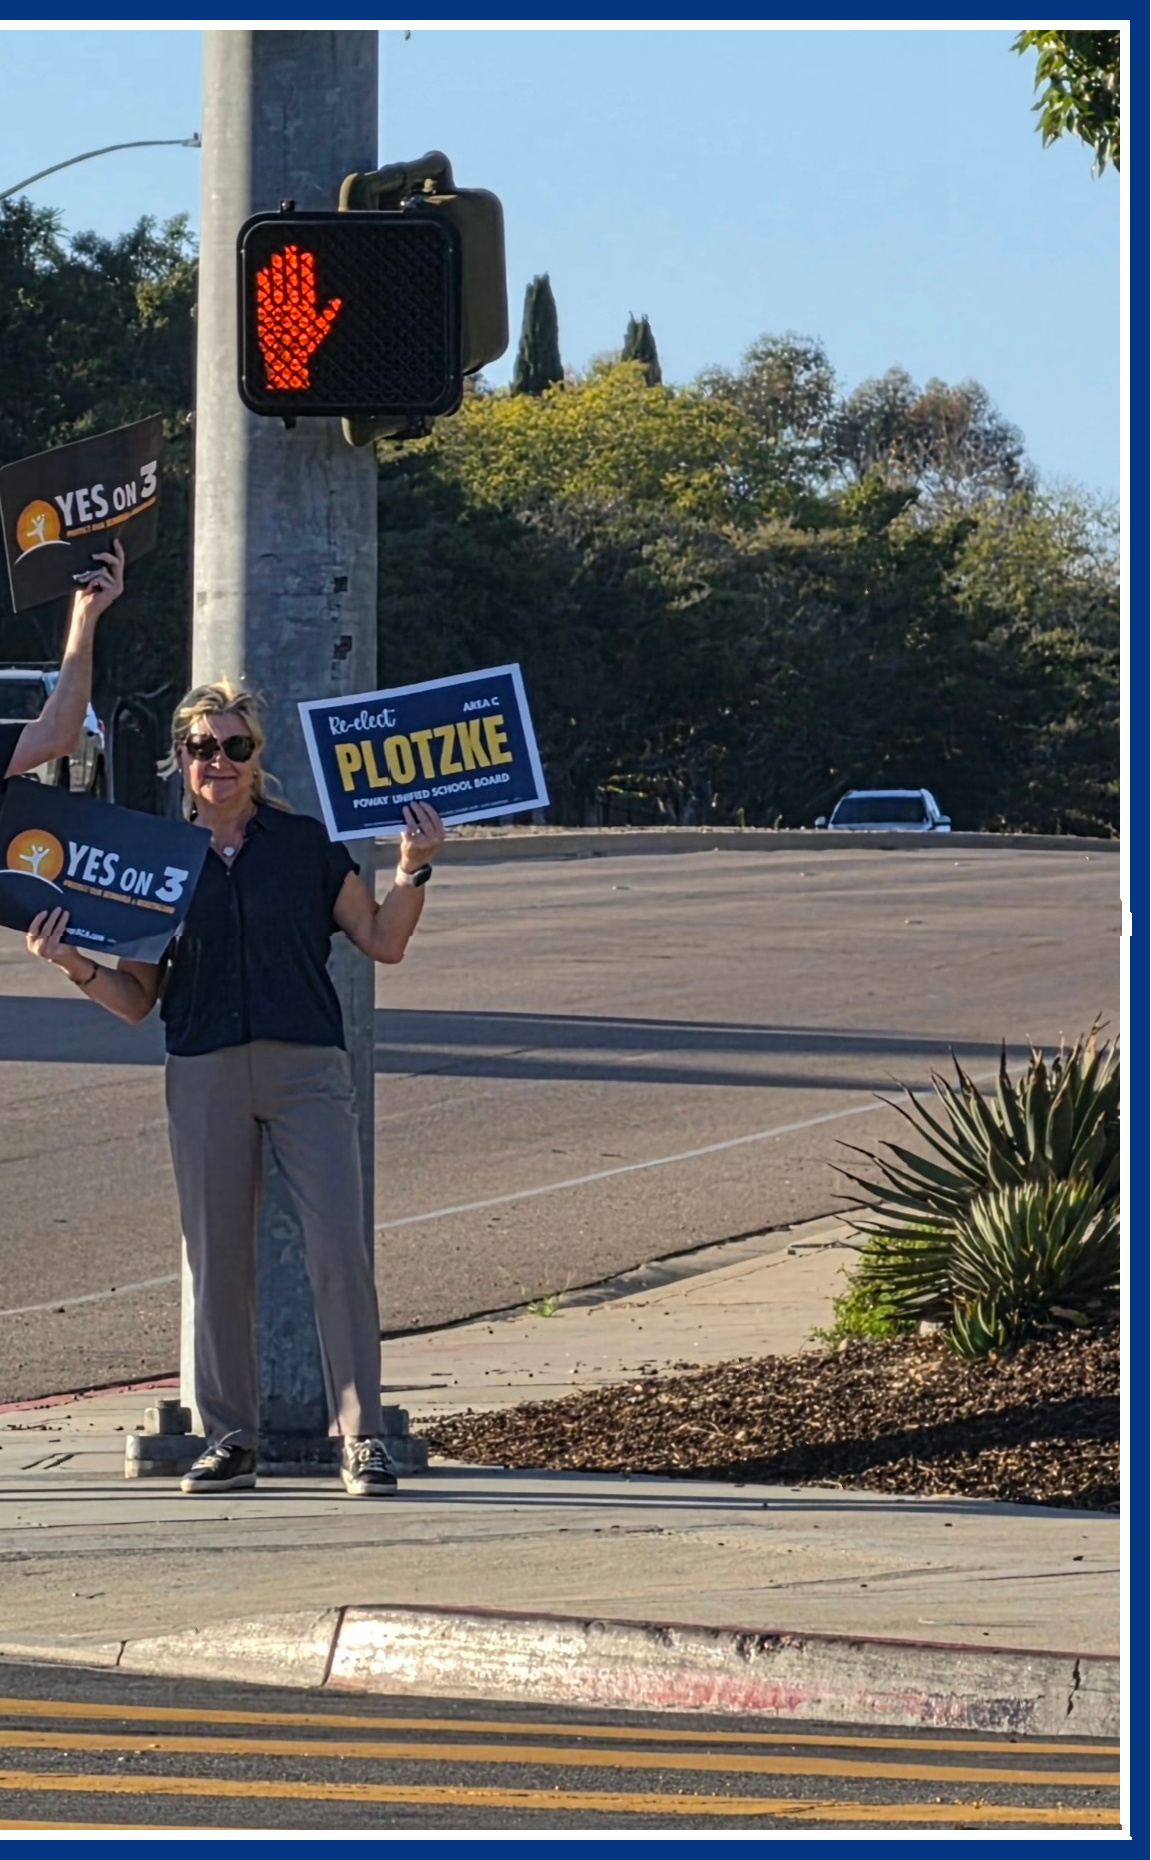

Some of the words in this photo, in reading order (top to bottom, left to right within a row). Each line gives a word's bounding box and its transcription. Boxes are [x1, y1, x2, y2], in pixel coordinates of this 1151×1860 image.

[54, 484, 110, 527] YES
[113, 481, 137, 511] ON
[140, 460, 158, 498] 3
[328, 708, 397, 736] Re-elect
[463, 699, 491, 713] AREA
[491, 696, 500, 706] C
[335, 714, 514, 792] PLOTZKE
[353, 795, 389, 809] POWAY
[392, 788, 431, 804] UNIFIED
[431, 781, 473, 797] SCHOOL
[474, 772, 511, 788] BOARD
[66, 841, 120, 887] YES
[120, 867, 154, 897] ON
[155, 865, 190, 903] 3
